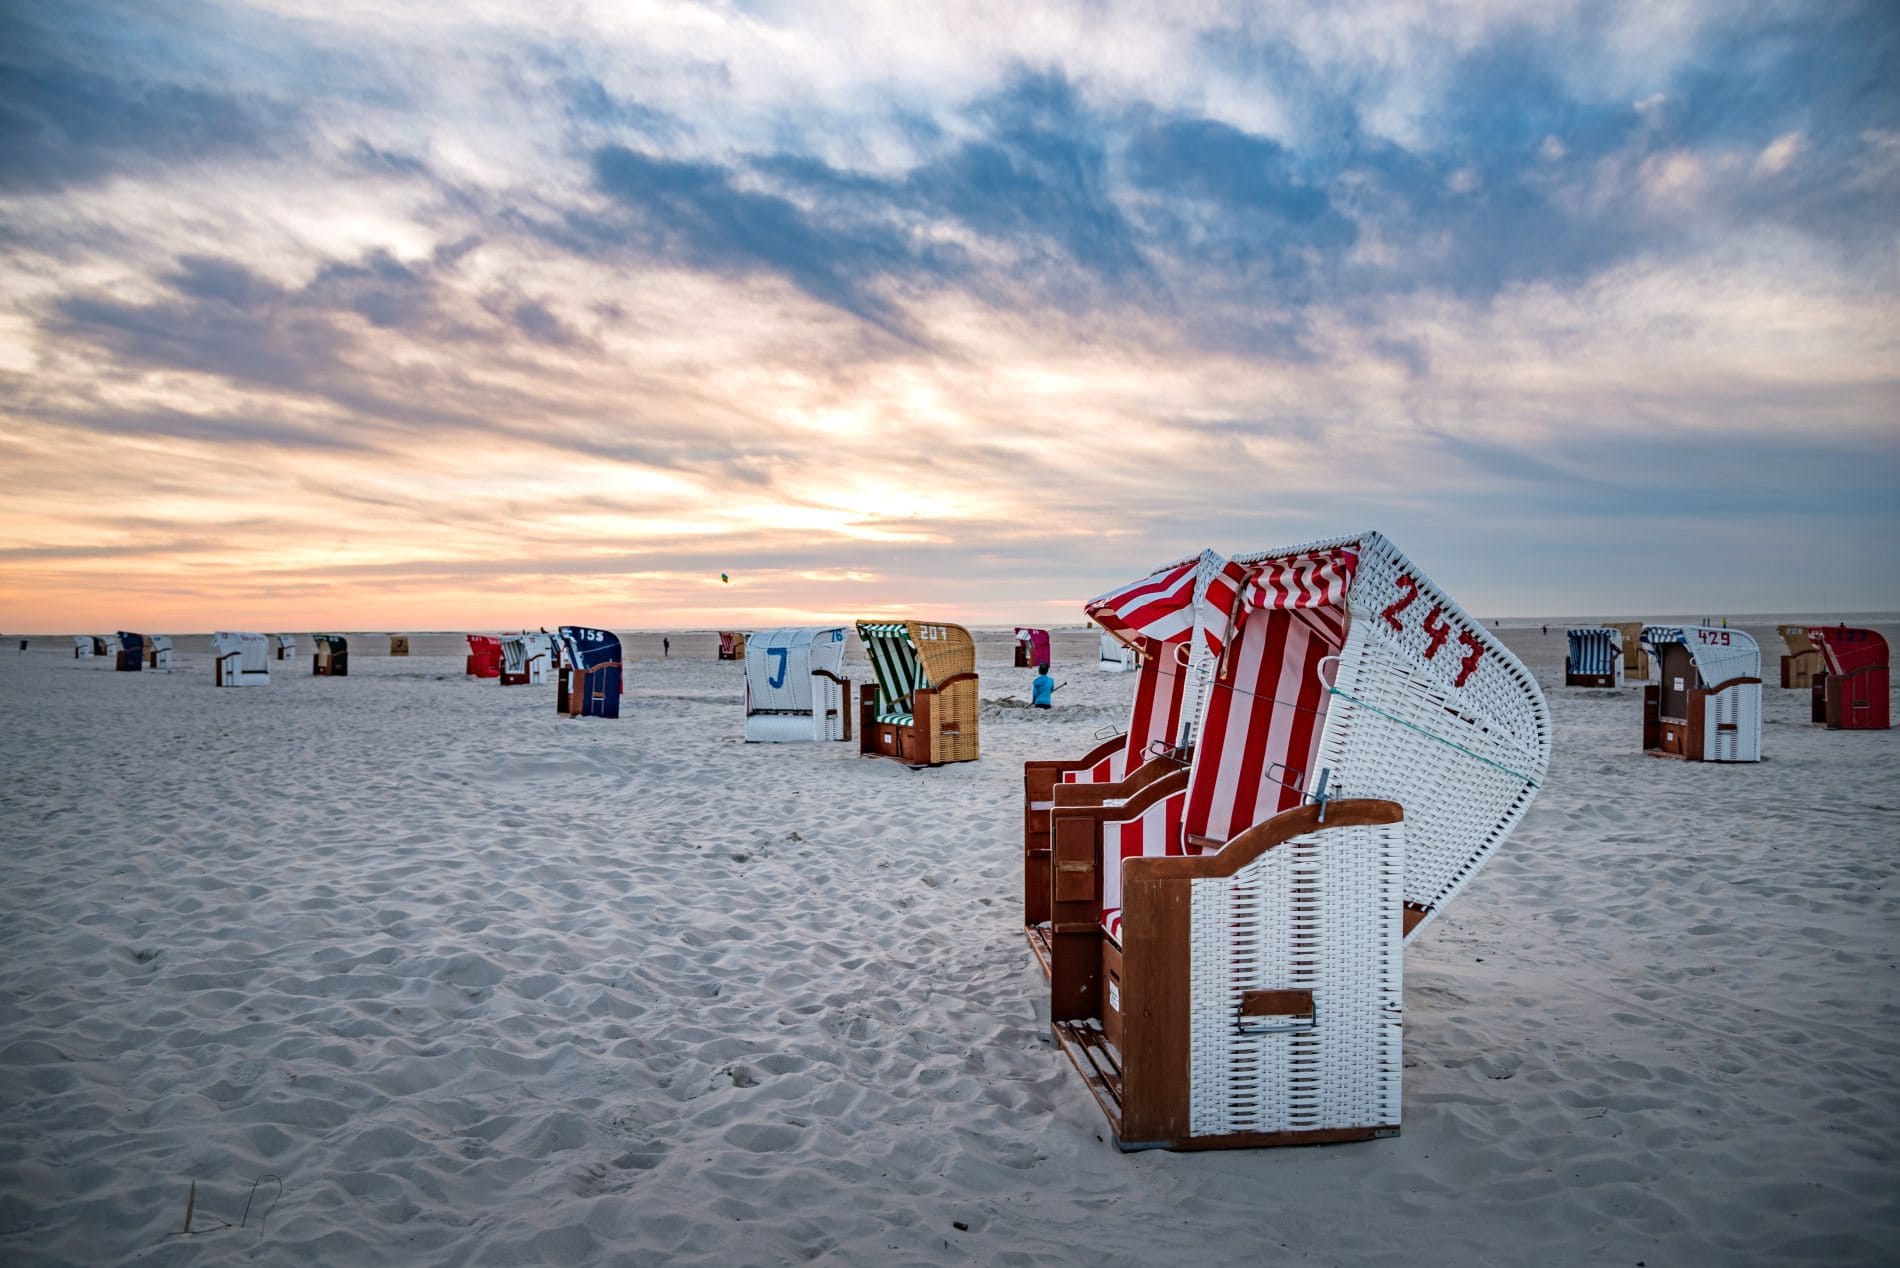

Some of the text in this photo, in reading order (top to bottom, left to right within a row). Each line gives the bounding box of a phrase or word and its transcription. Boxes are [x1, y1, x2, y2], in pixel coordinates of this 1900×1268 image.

[1381, 573, 1485, 689] 247
[1698, 630, 1730, 646] 429
[767, 647, 787, 689] J
